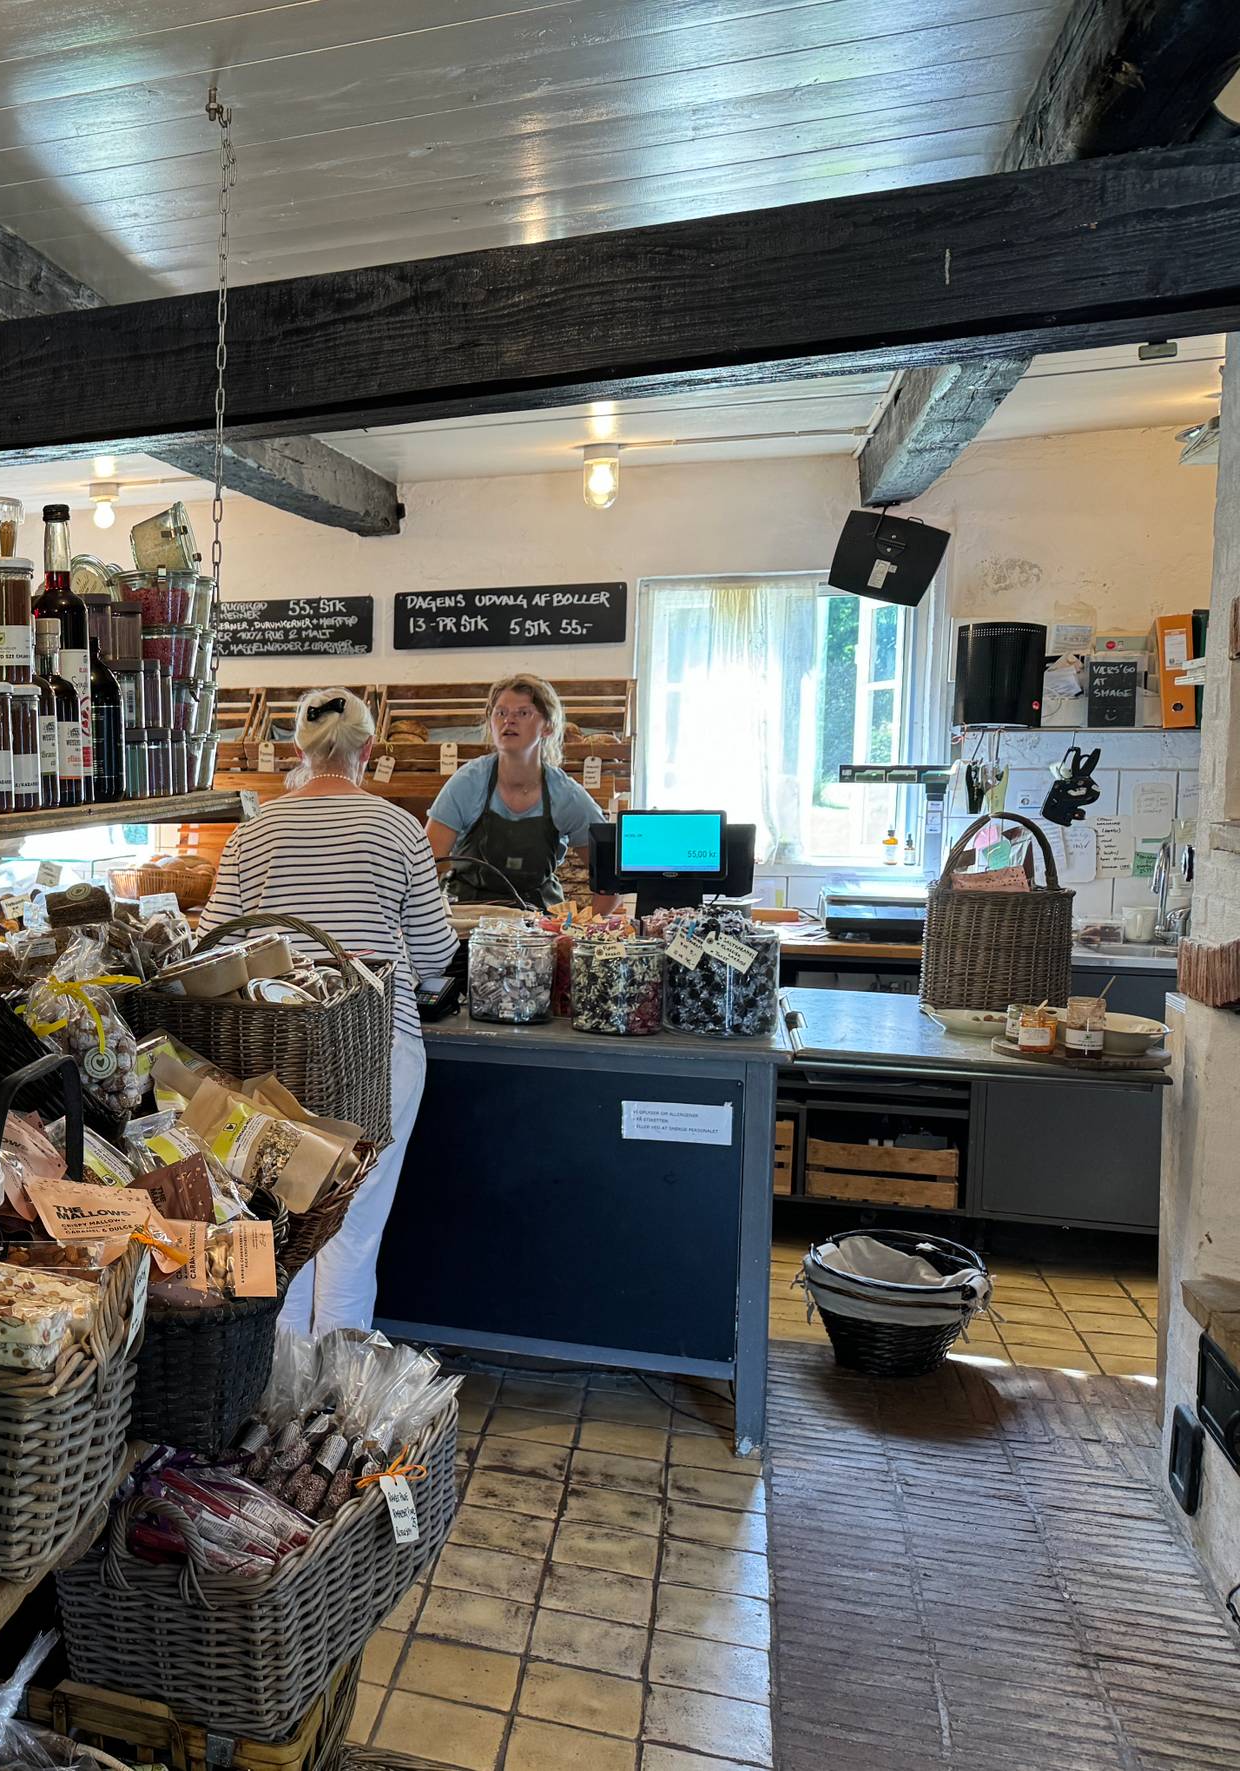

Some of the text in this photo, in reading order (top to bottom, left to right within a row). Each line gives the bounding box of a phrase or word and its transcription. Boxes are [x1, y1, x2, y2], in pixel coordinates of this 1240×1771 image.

[319, 599, 347, 613] STK
[406, 591, 610, 611] DAGENS UDVALG AF BOLLER
[460, 615, 489, 632] STK
[509, 617, 522, 635] 5
[524, 618, 551, 637] STK
[302, 629, 335, 639] MALT
[1093, 677, 1107, 686] AT
[1093, 688, 1133, 698] SMAGE
[687, 850, 707, 858] 55,00
[53, 1204, 82, 1213] THE
[55, 1209, 132, 1220] MALLOWS
